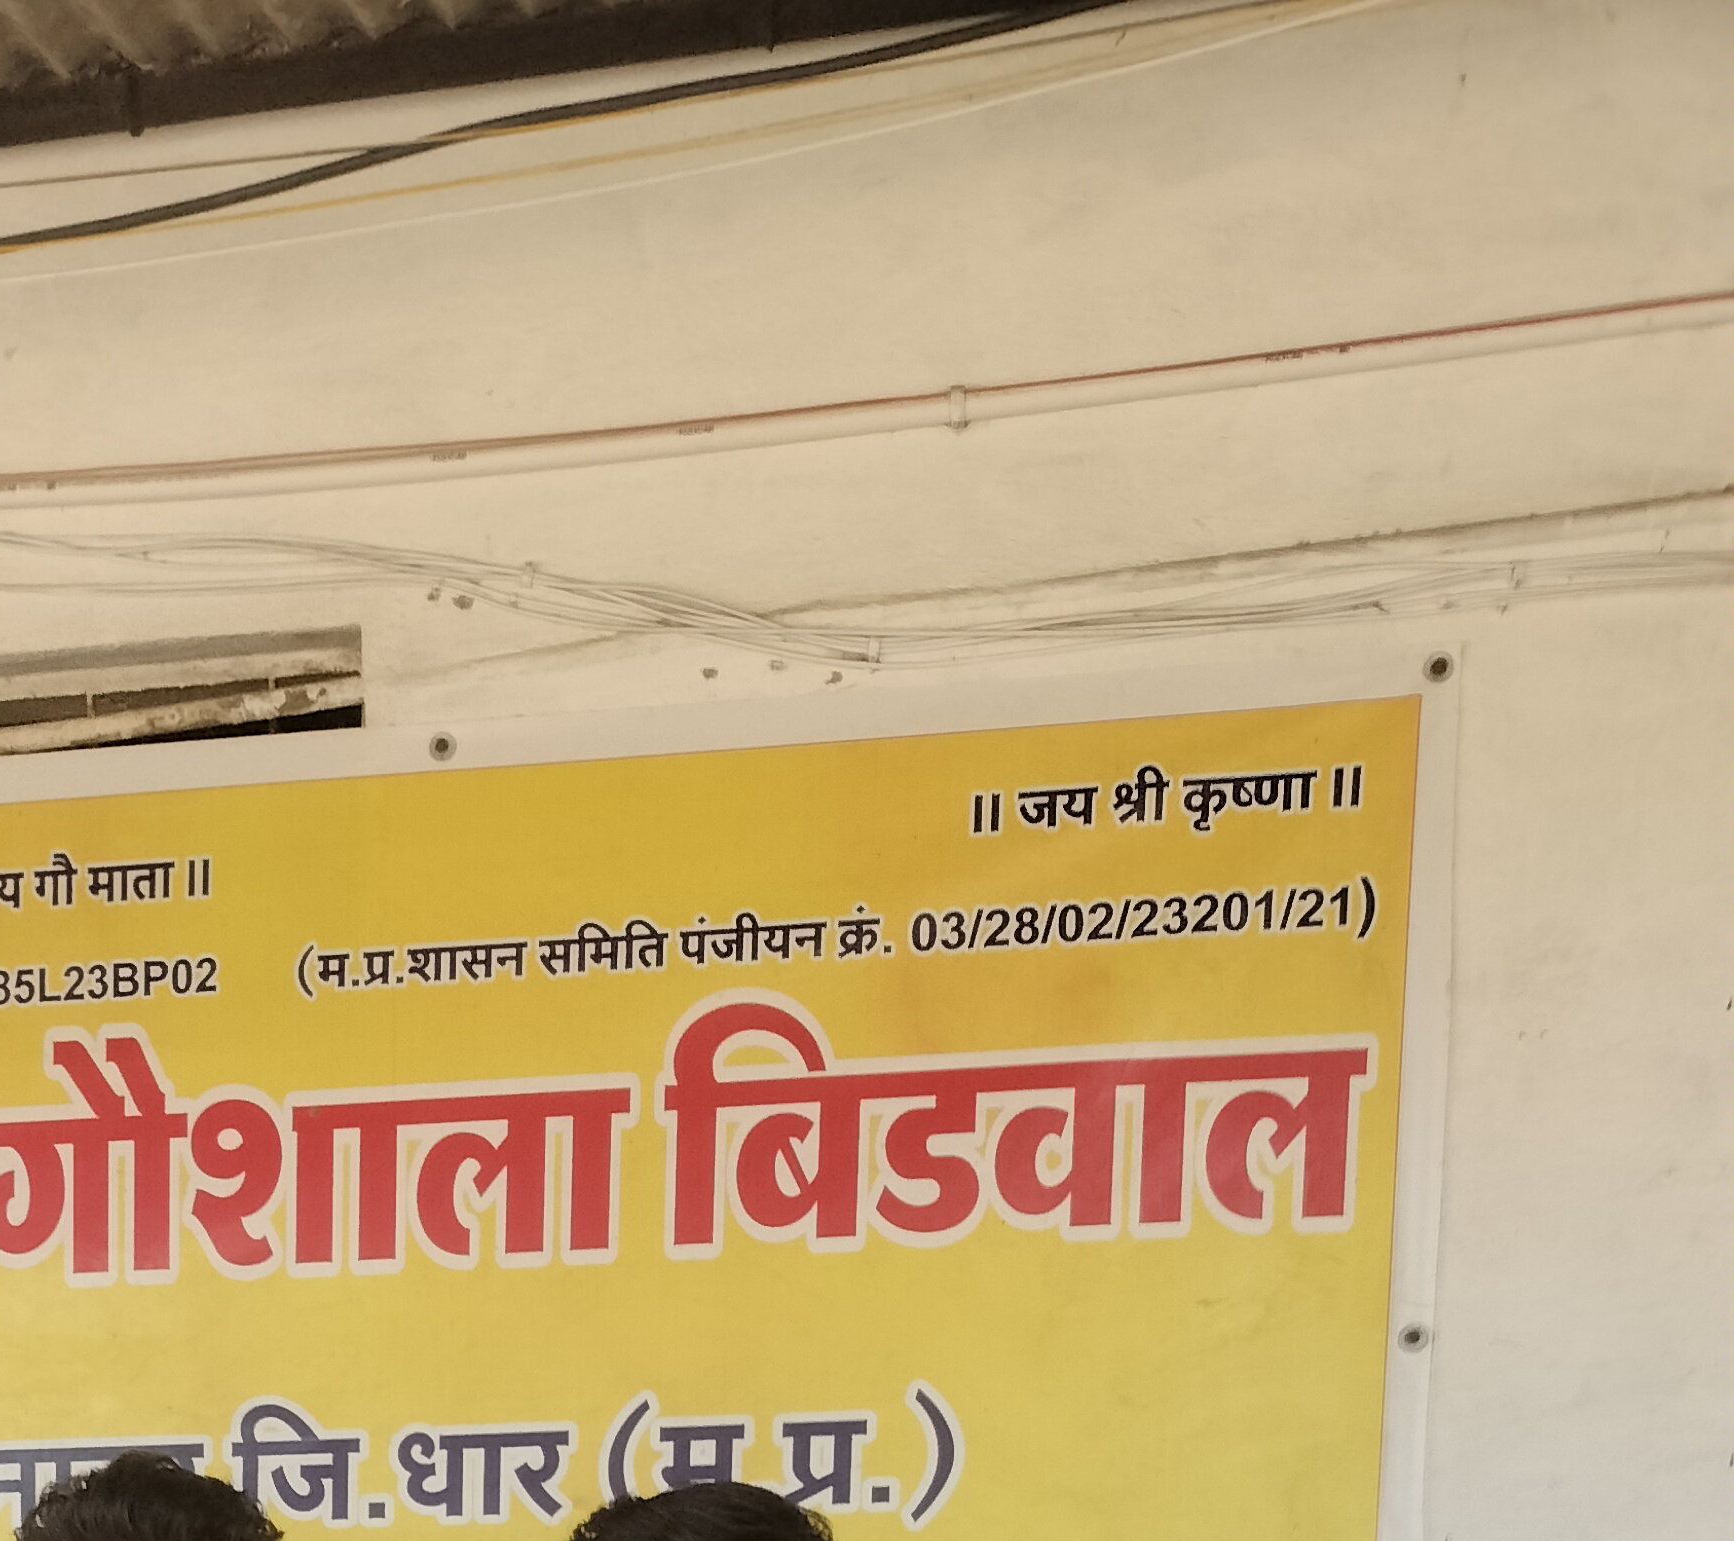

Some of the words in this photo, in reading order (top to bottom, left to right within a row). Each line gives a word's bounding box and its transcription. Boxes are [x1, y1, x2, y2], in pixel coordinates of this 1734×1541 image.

[1019, 788, 1097, 828] जय
[1115, 766, 1168, 823] श्री
[1185, 770, 1317, 830] कृष्णा
[35, 855, 76, 907] गौ
[88, 862, 174, 903] माता
[539, 920, 669, 973] समिति
[681, 912, 827, 964] पंजीयन
[913, 877, 1376, 952] 03/28/02/23201/21)
[665, 1002, 1370, 1248] बिडवाल
[608, 1388, 955, 1523] (मप्र.)
